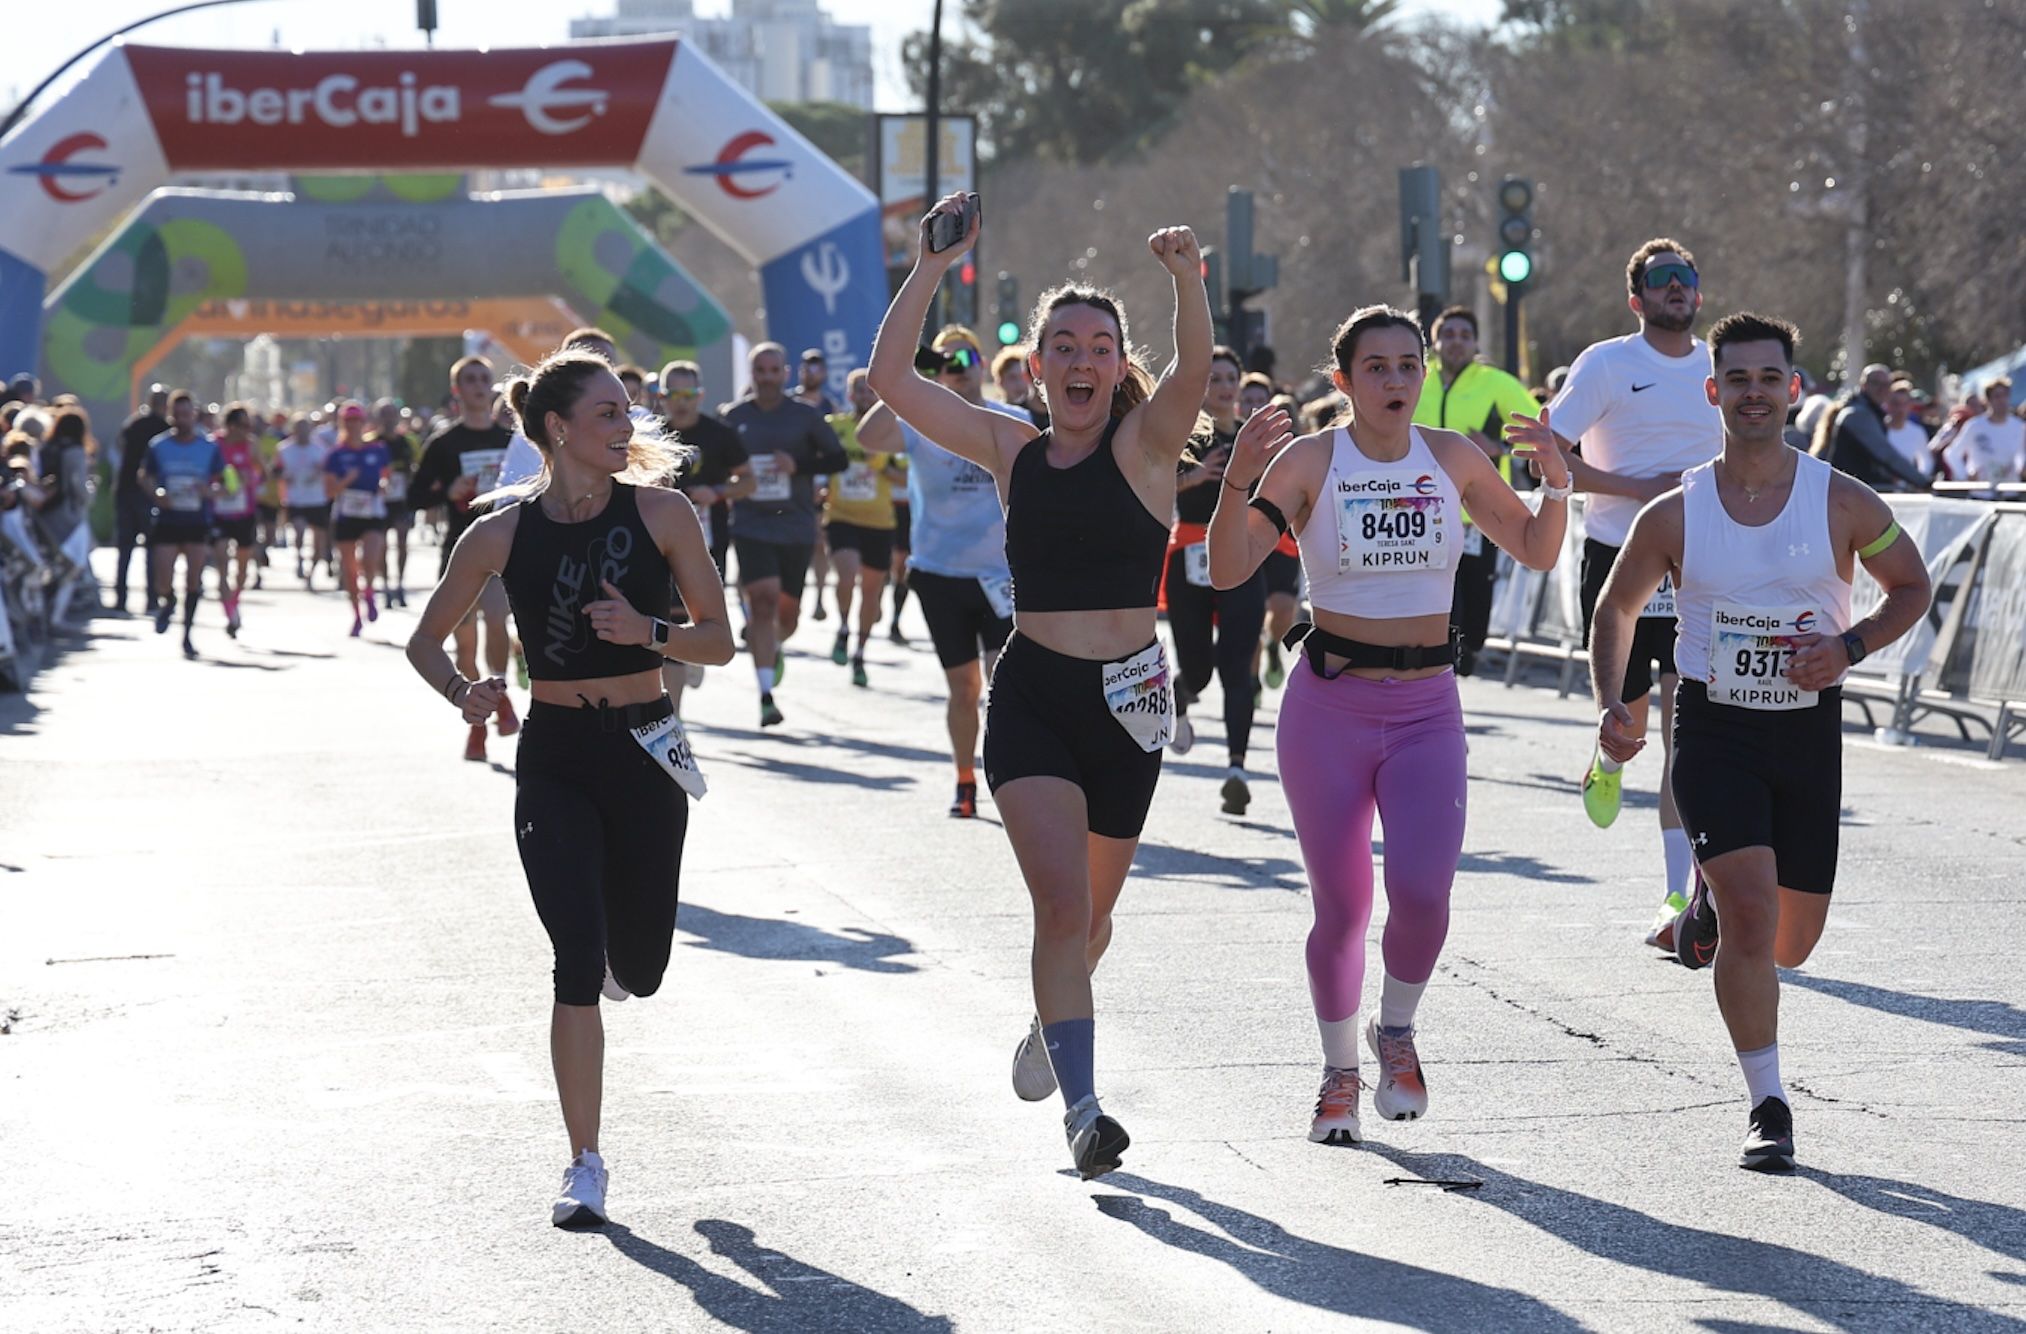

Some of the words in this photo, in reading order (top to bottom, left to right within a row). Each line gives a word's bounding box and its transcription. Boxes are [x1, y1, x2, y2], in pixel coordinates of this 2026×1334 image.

[186, 72, 461, 137] iberCaja
[1338, 480, 1400, 493] iberCaja
[1362, 511, 1425, 539] 8409
[1435, 532, 1442, 543] 9
[599, 526, 633, 587] RO
[1363, 551, 1429, 567] KIPRUN
[544, 554, 587, 667] NIKE
[1716, 611, 1780, 631] iberCaja
[1730, 688, 1798, 704] KIPRUN
